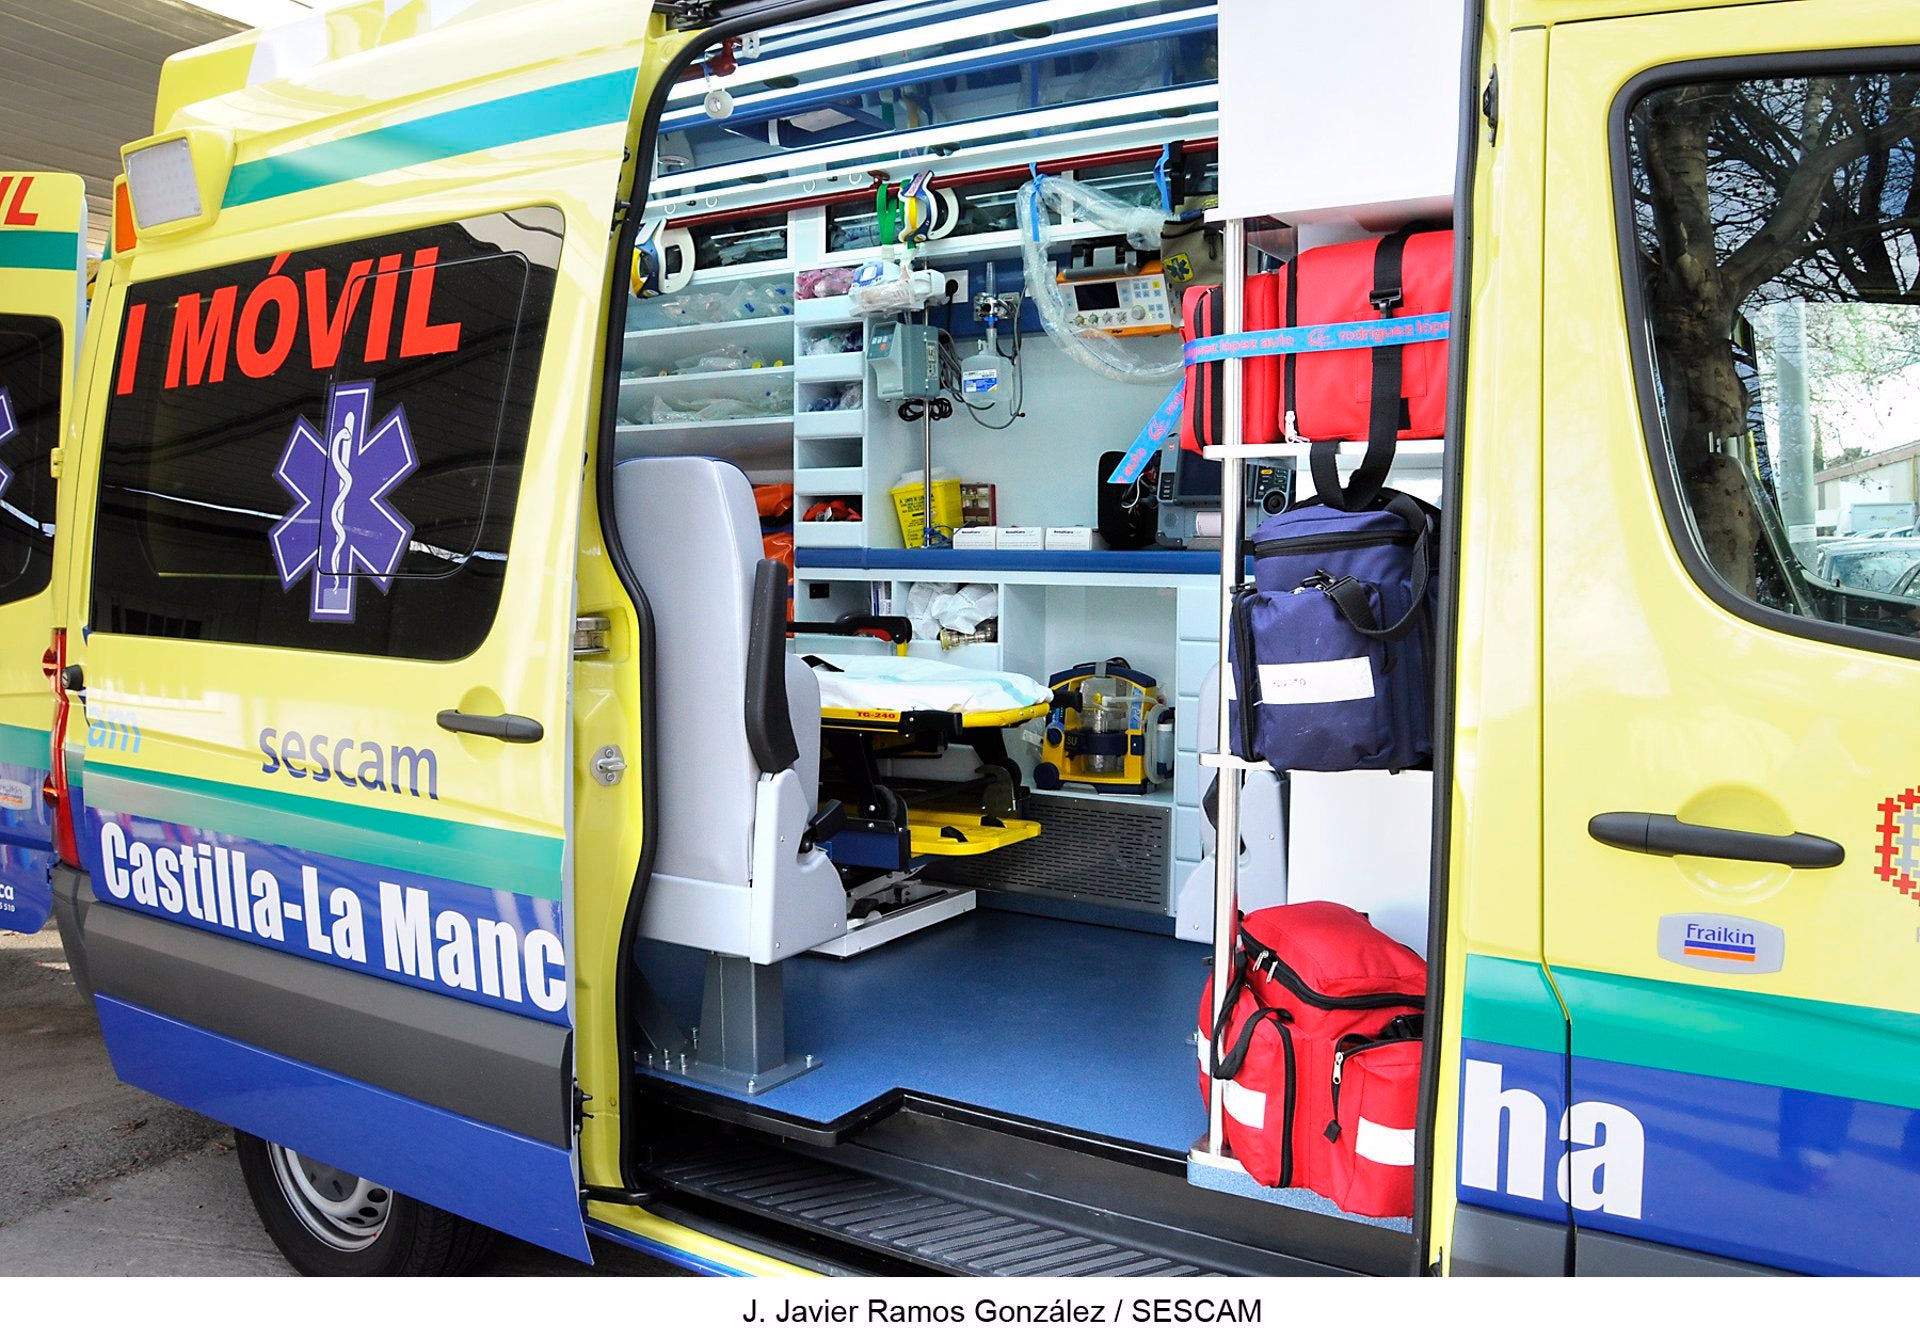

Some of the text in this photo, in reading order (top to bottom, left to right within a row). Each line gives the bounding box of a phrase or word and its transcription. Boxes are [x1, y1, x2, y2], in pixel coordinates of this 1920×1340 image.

[164, 246, 462, 390] MÓVIL
[258, 727, 439, 800] sescam
[856, 711, 896, 719] TG-240
[101, 822, 568, 1012] Castilla-La Manc
[1686, 923, 1755, 945] Fraikin
[1461, 1059, 1645, 1220] ha
